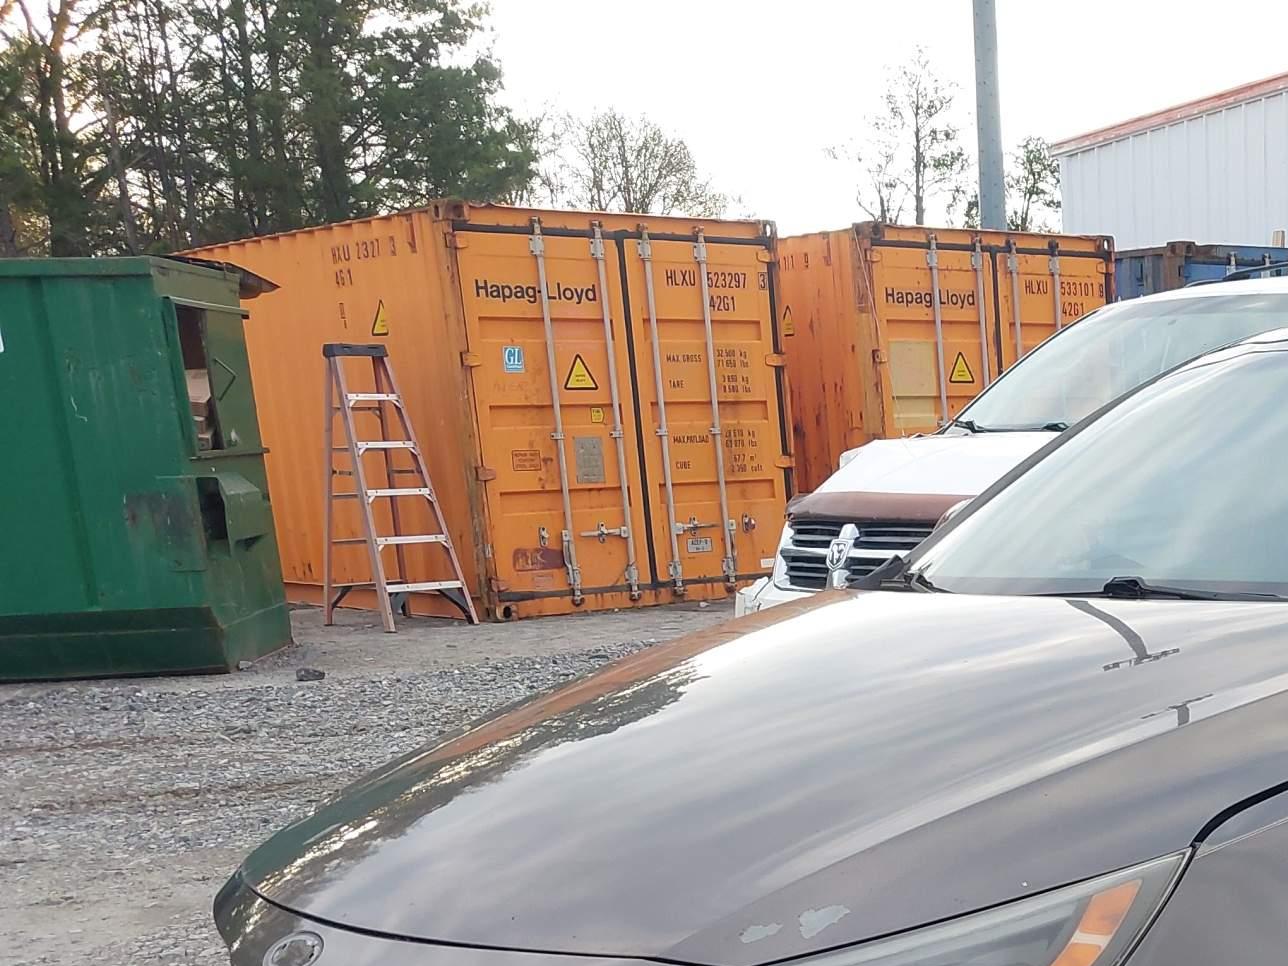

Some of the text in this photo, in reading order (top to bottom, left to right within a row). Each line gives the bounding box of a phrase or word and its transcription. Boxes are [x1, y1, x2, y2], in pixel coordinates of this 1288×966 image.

[665, 269, 696, 287] HLXU
[706, 271, 747, 289] 523297
[475, 279, 597, 305] Hapag-Lloyd
[1025, 280, 1048, 295] HLXU
[1061, 281, 1094, 297] 533101
[708, 295, 736, 312] 42G1
[885, 287, 975, 309] HapagLloyd
[1062, 302, 1084, 317] 42G1
[505, 347, 522, 364] GL
